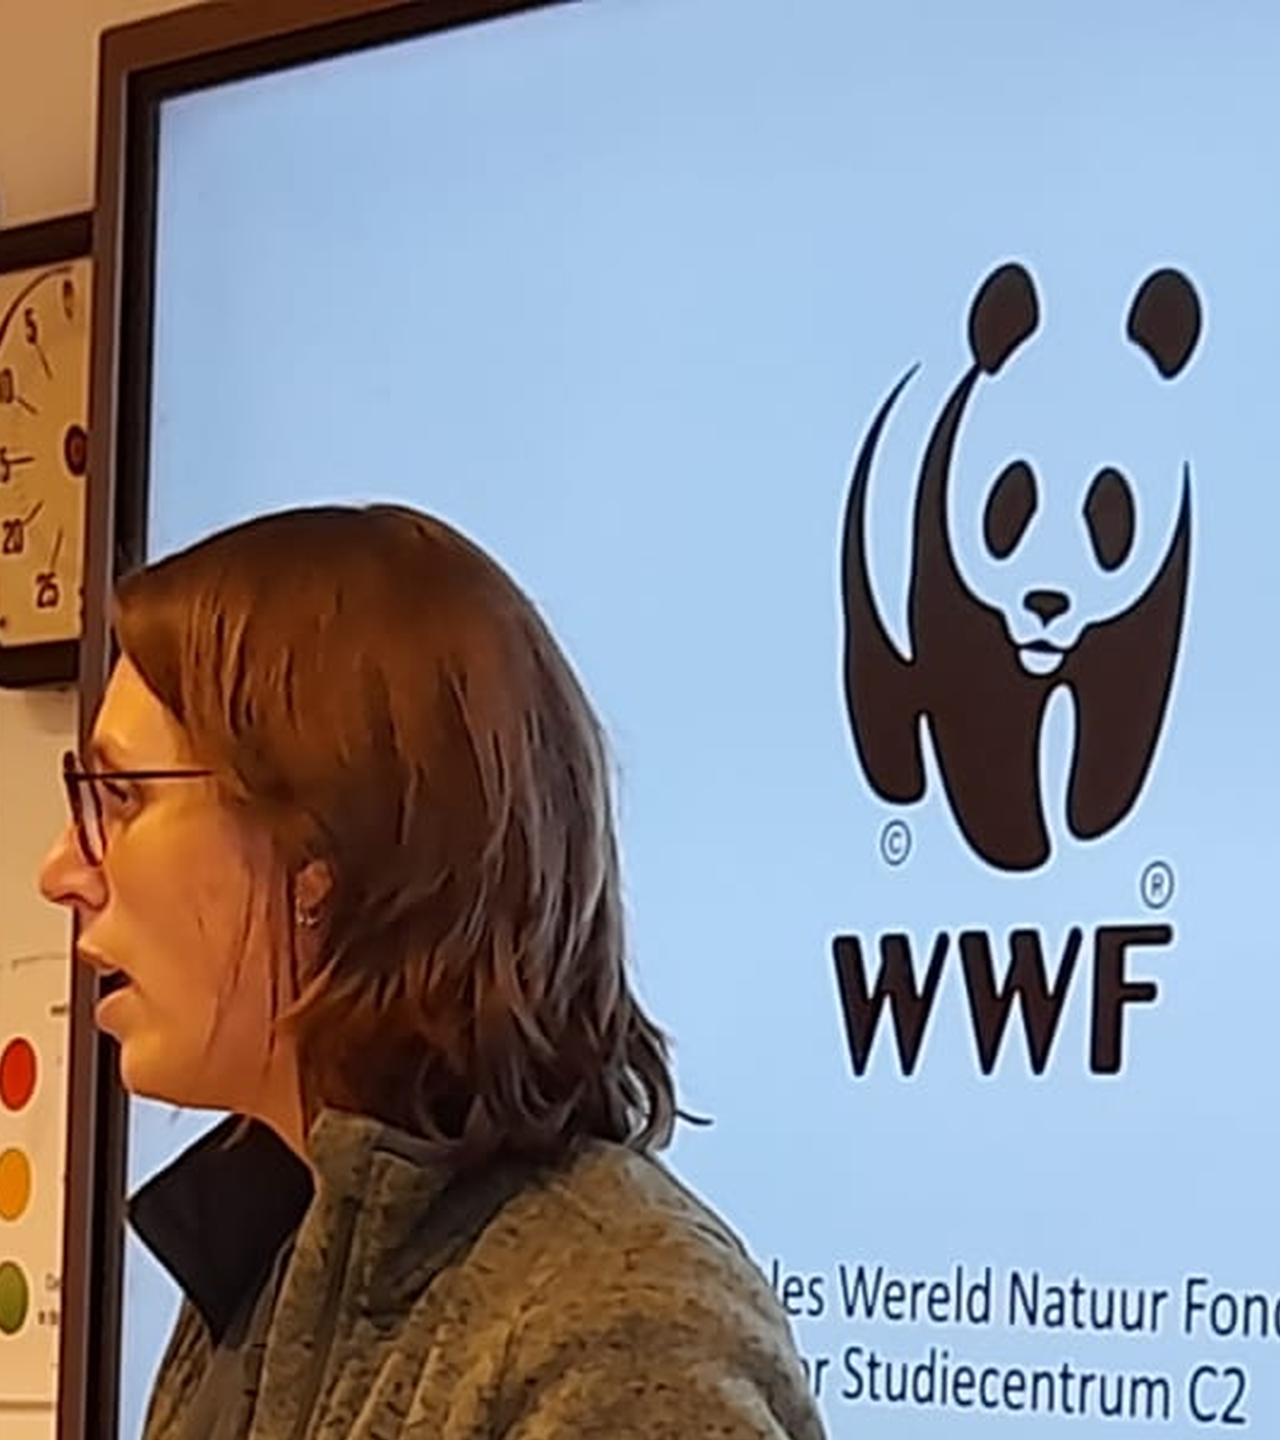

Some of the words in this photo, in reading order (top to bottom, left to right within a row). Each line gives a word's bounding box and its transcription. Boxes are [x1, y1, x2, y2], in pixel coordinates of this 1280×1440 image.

[24, 307, 38, 345] 5
[2, 517, 25, 555] 20
[35, 571, 60, 609] 25
[830, 922, 1174, 1078] WWF
[838, 1263, 992, 1324] Wereld
[1008, 1271, 1169, 1334] Natuur
[840, 1345, 1171, 1421] Studiecentrum
[1187, 1364, 1248, 1425] C2
